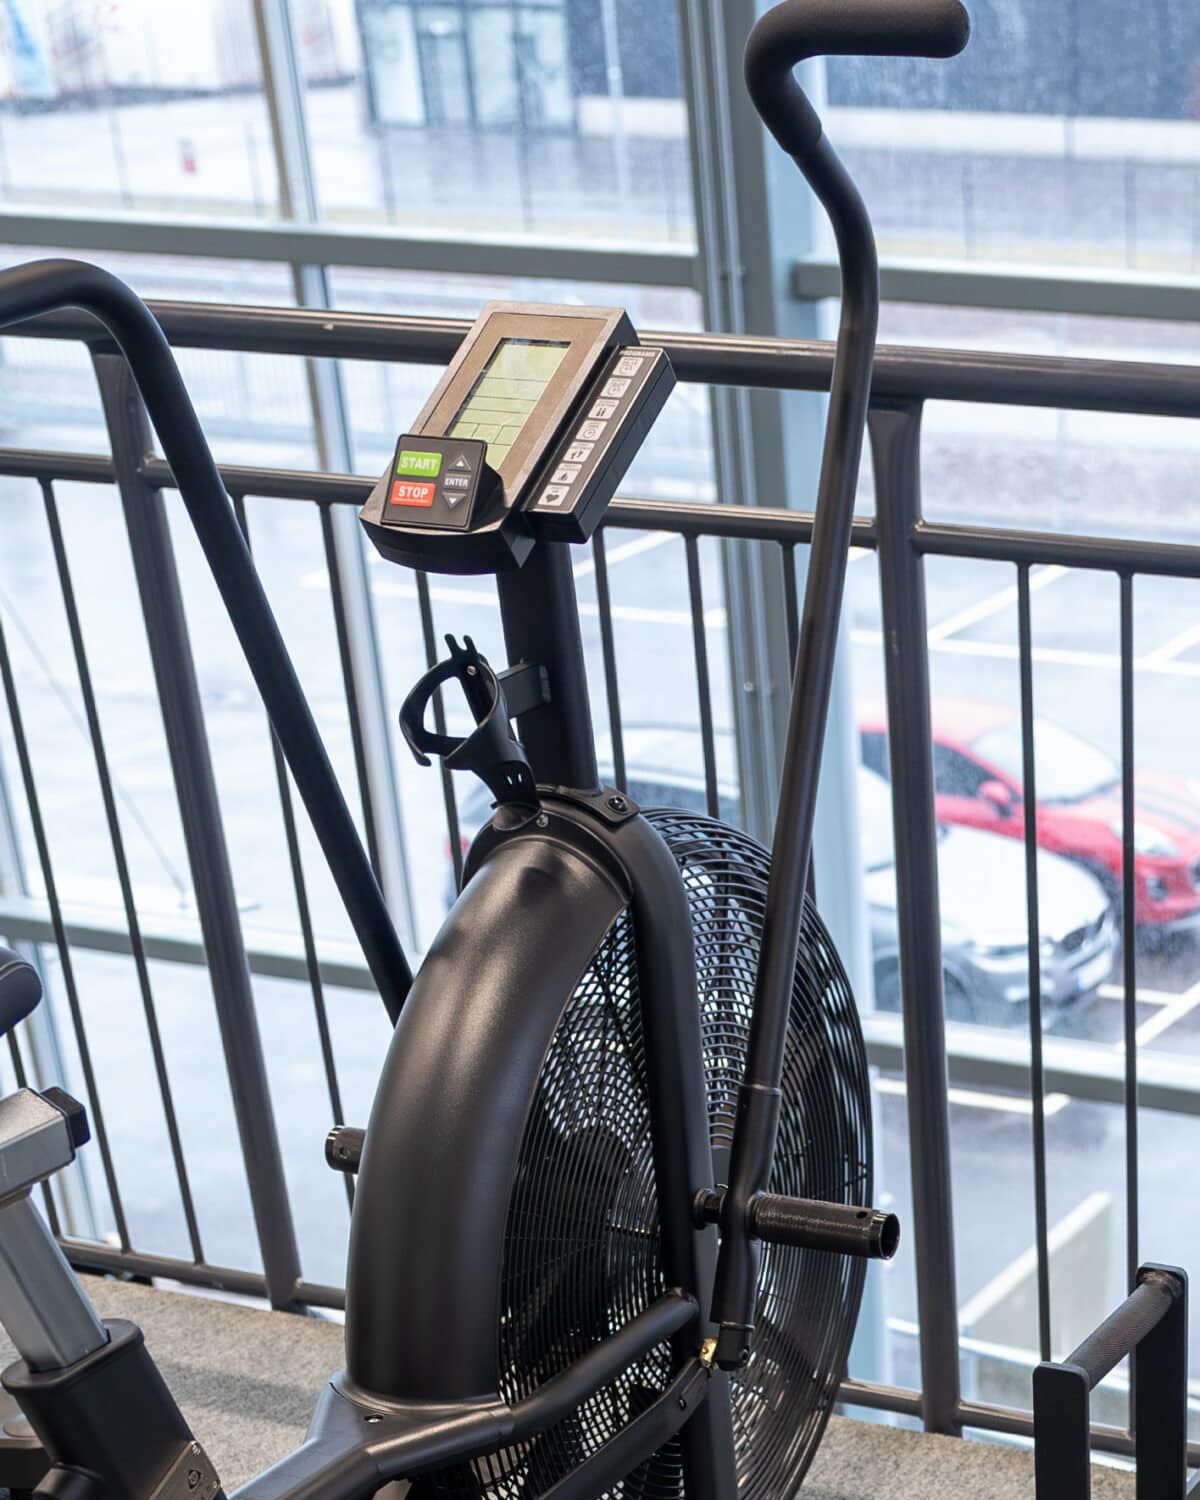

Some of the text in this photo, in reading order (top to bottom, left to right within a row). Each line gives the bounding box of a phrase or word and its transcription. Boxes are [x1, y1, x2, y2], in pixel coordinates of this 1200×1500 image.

[401, 457, 438, 471] START
[445, 477, 469, 488] ENTER
[399, 486, 429, 498] STOP
